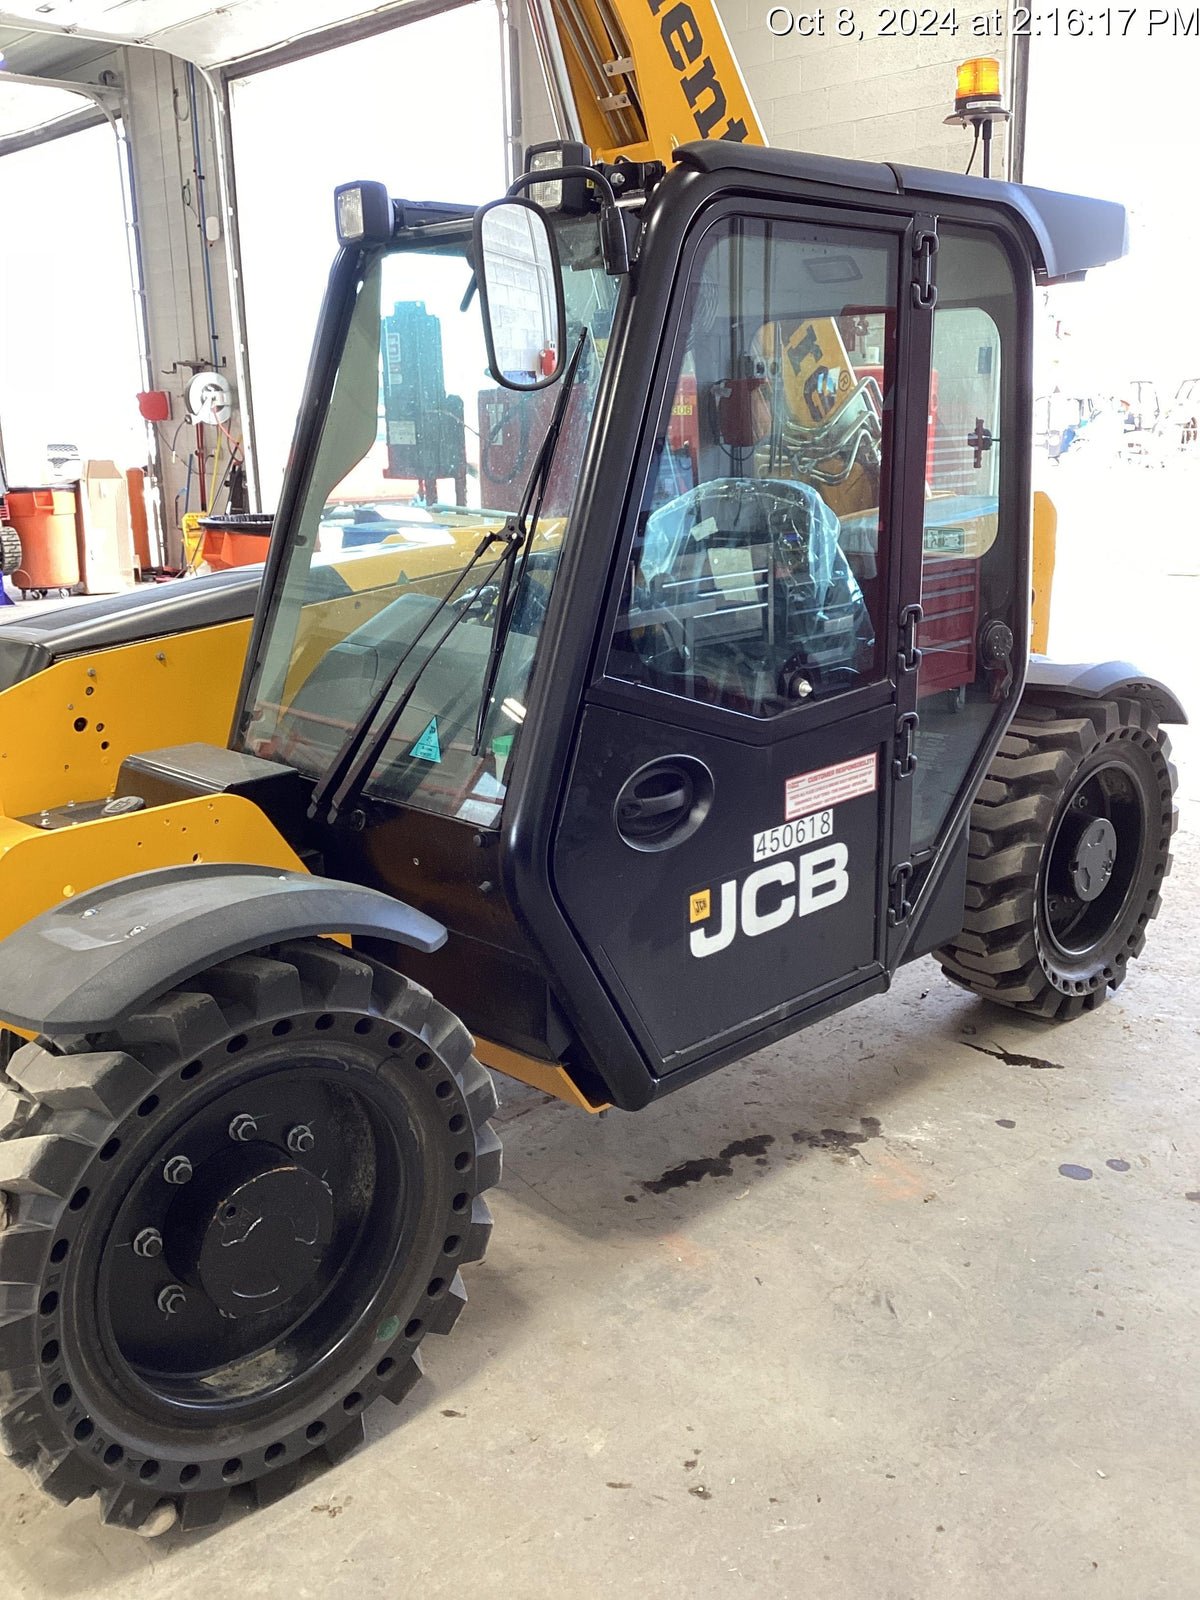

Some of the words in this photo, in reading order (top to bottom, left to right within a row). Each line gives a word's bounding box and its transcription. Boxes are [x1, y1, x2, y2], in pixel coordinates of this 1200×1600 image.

[648, 0, 748, 142] ent
[756, 811, 831, 856] 450618
[690, 842, 849, 958] JCB
[694, 899, 707, 913] JCB
